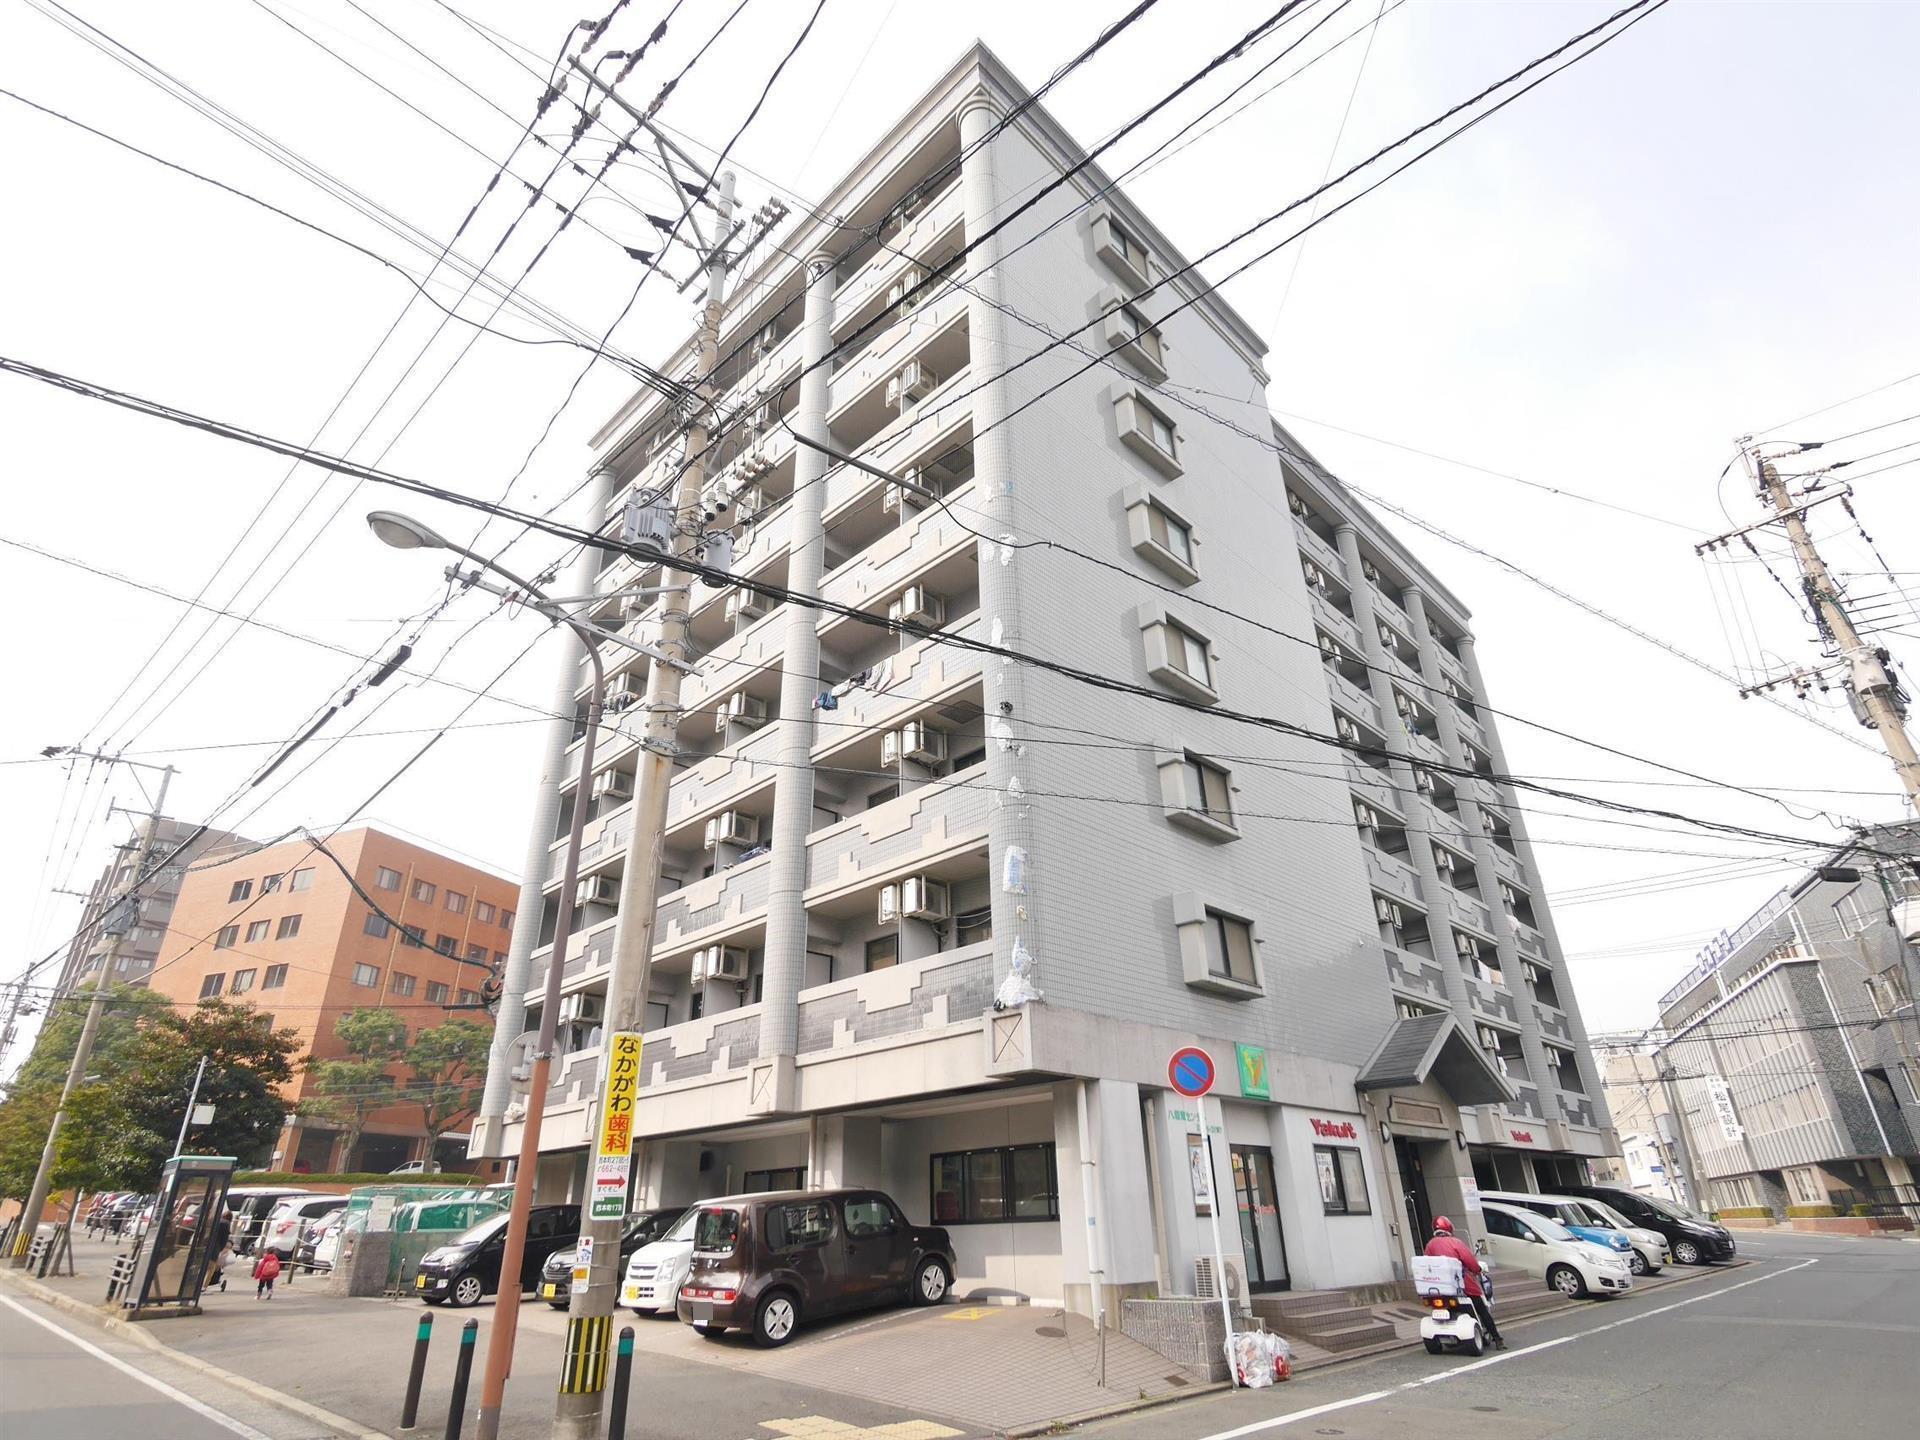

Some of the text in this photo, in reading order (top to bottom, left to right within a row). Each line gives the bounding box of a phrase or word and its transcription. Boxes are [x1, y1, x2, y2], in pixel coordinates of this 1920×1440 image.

[606, 1036, 639, 1152] なかがわ歯科
[1310, 1118, 1357, 1139] Yakult
